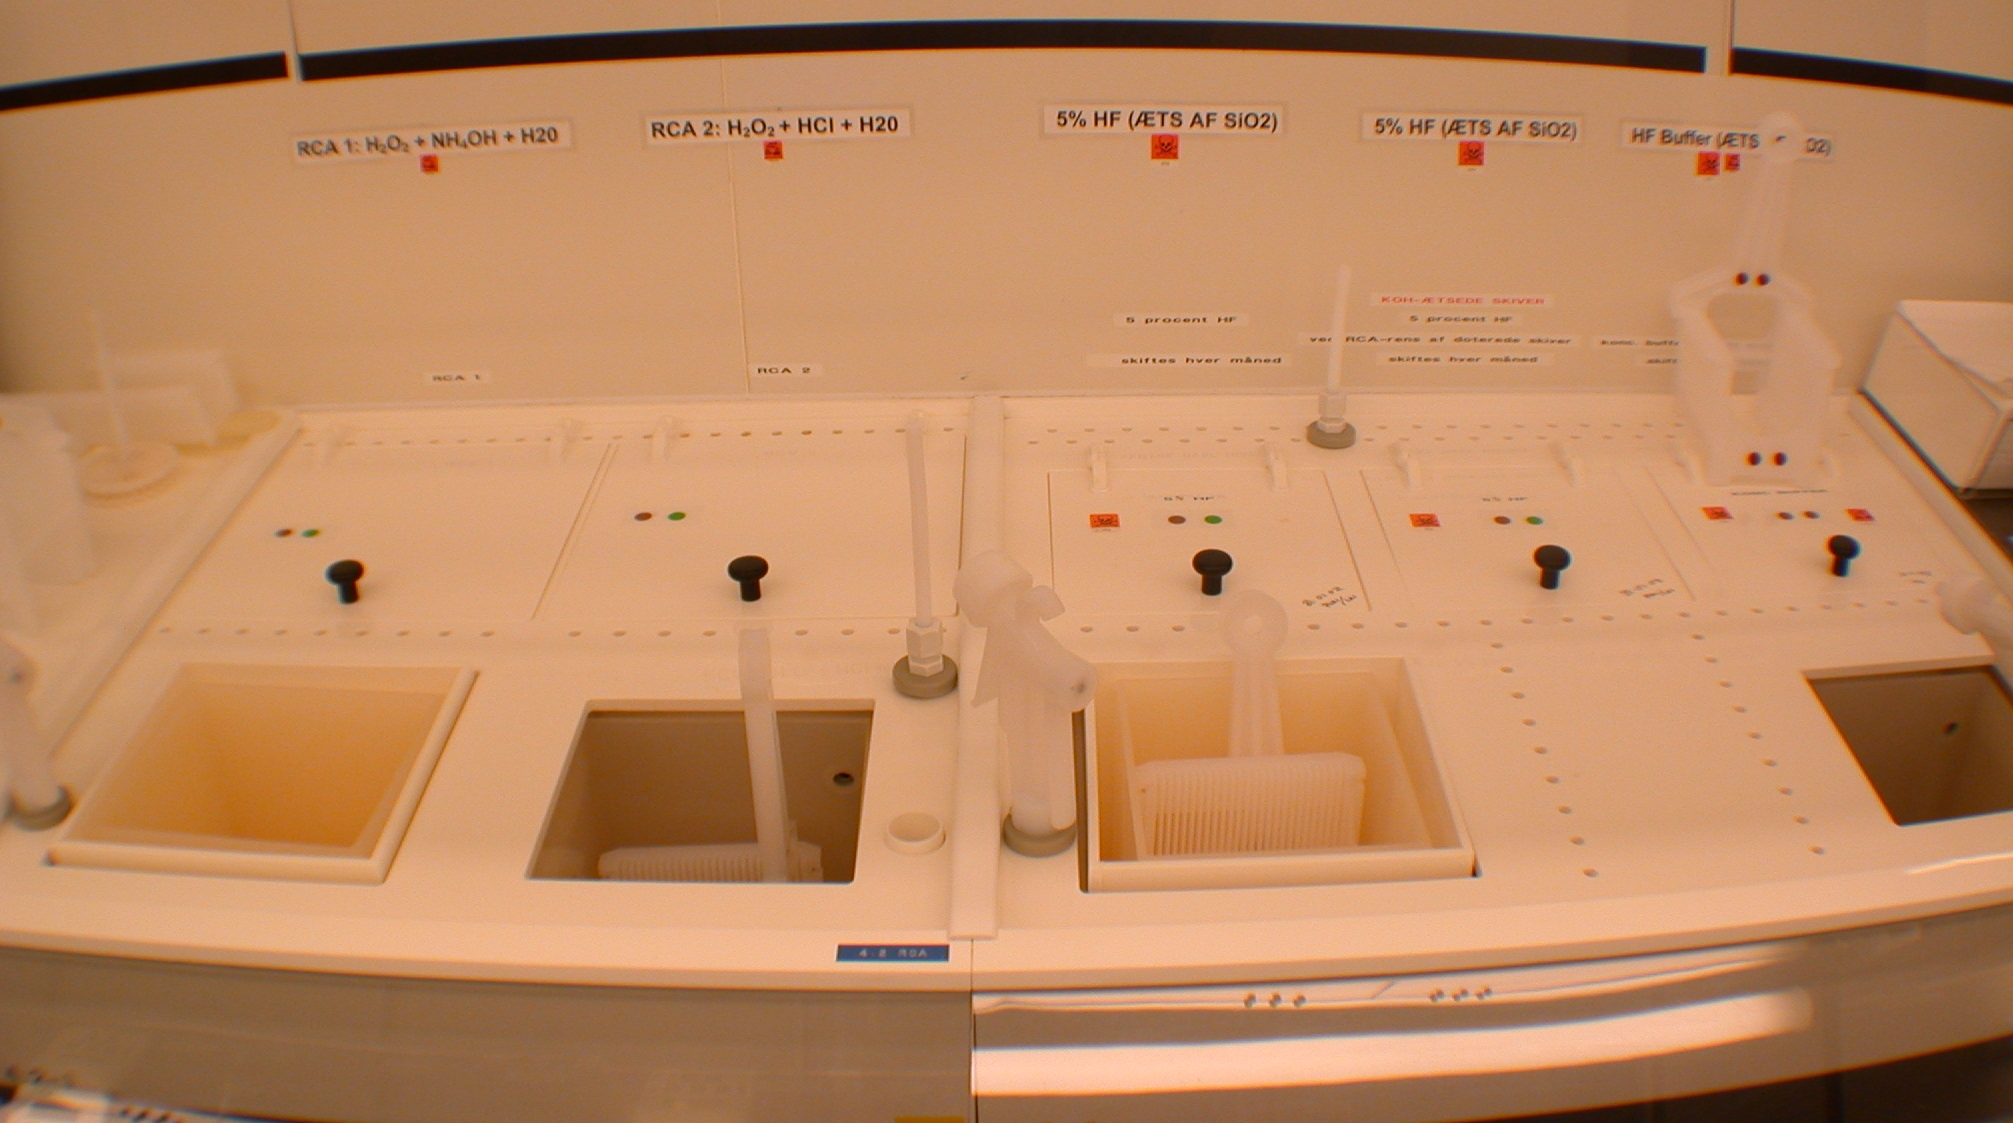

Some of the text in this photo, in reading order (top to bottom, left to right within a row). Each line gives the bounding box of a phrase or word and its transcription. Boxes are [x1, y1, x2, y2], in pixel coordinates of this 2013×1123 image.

[1056, 110, 1279, 133] 5% HF (ÆTS AF SiO2)
[651, 120, 697, 138] RCA
[702, 120, 720, 137] 2:
[1375, 117, 1578, 143] 5% HF (ÆTS AF SiO2)
[1631, 127, 1657, 145] HF
[1659, 128, 1712, 147] Buffer
[297, 138, 339, 157] RCA
[343, 137, 360, 154] 1:
[1125, 316, 1238, 325] 5 procent HF
[1425, 315, 1487, 323] procent
[1120, 356, 1177, 365] skiftes
[1185, 356, 1221, 365] hver
[1388, 355, 1442, 363] skiftes
[757, 366, 793, 375] RCA
